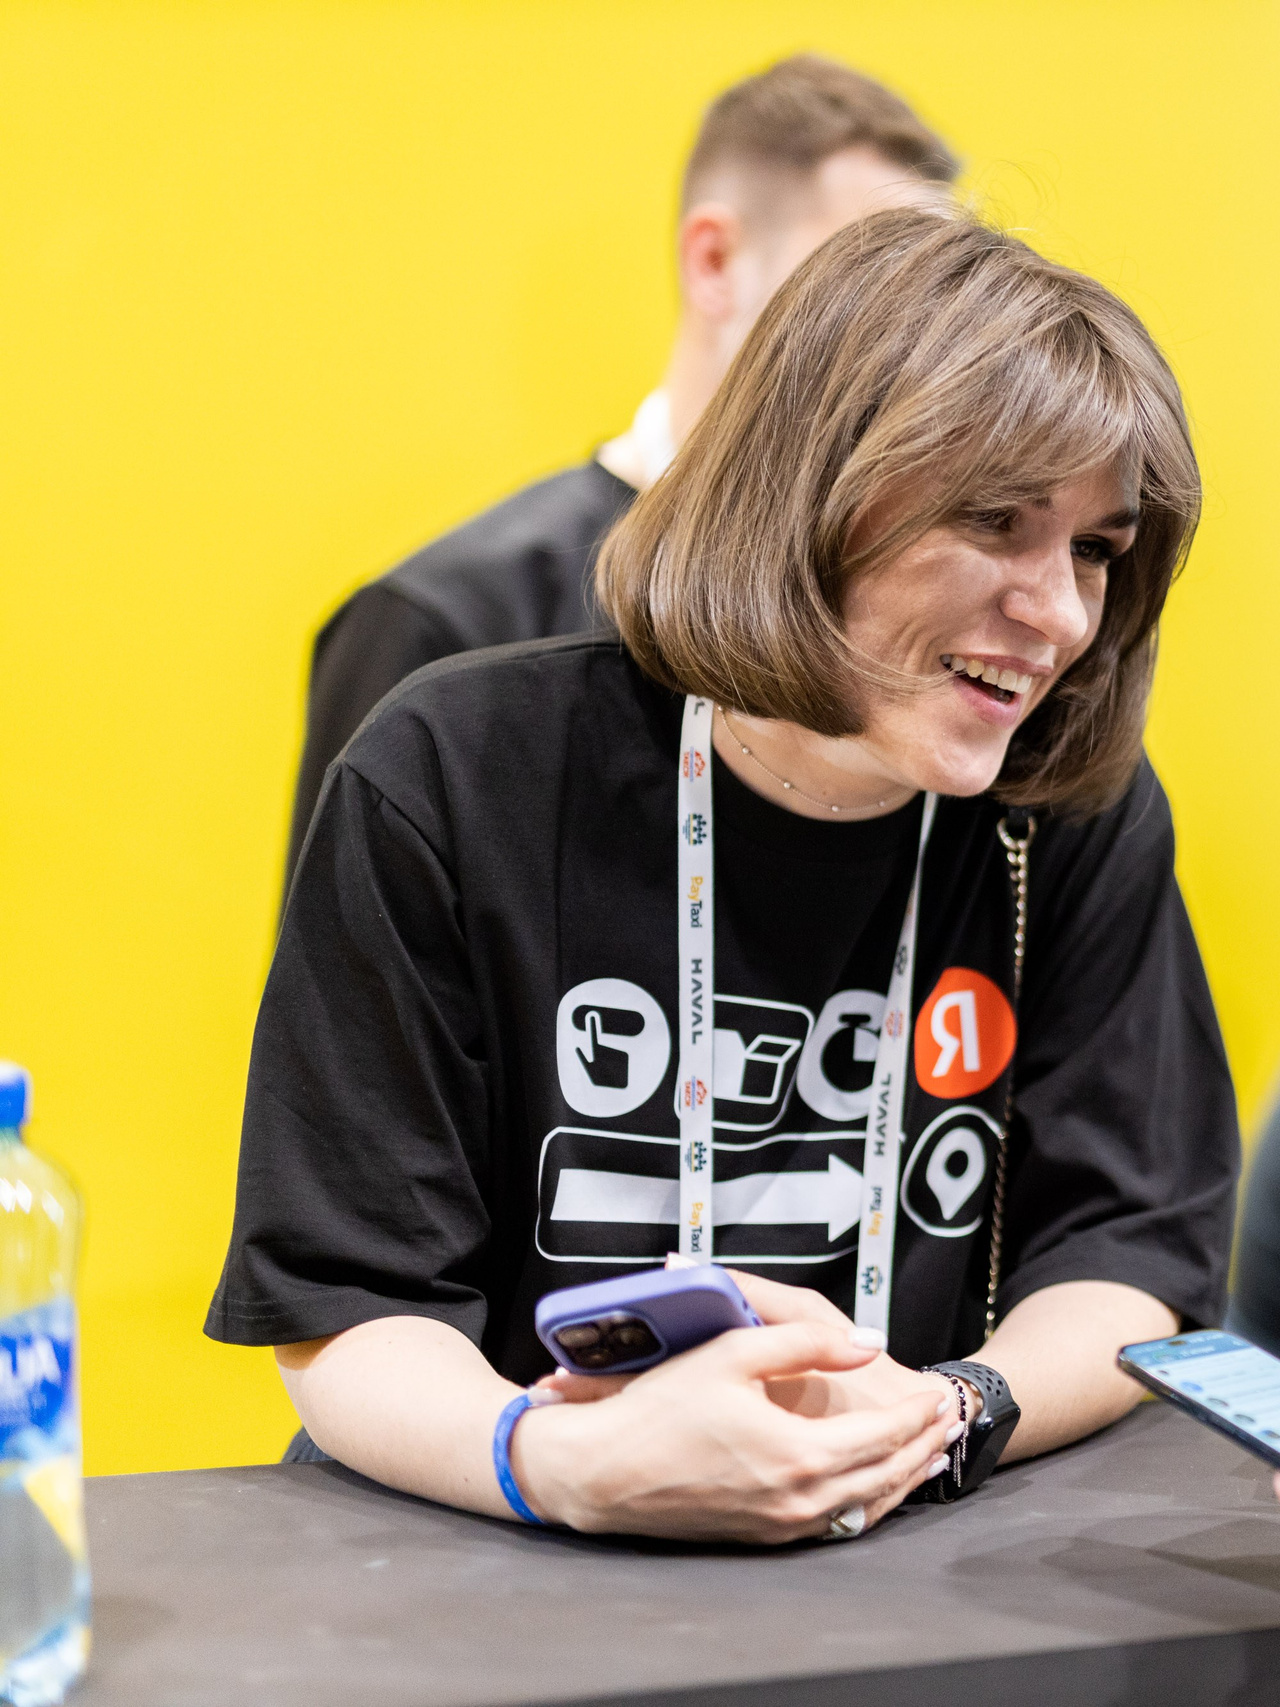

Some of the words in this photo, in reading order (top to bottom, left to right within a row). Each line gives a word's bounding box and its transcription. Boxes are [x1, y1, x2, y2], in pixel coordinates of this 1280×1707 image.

[688, 876, 703, 928] PayTaxi
[691, 959, 702, 1045] HAVAL
[930, 990, 980, 1077] Я
[874, 1073, 891, 1156] HAVAL
[689, 1202, 703, 1252] PayTaxi
